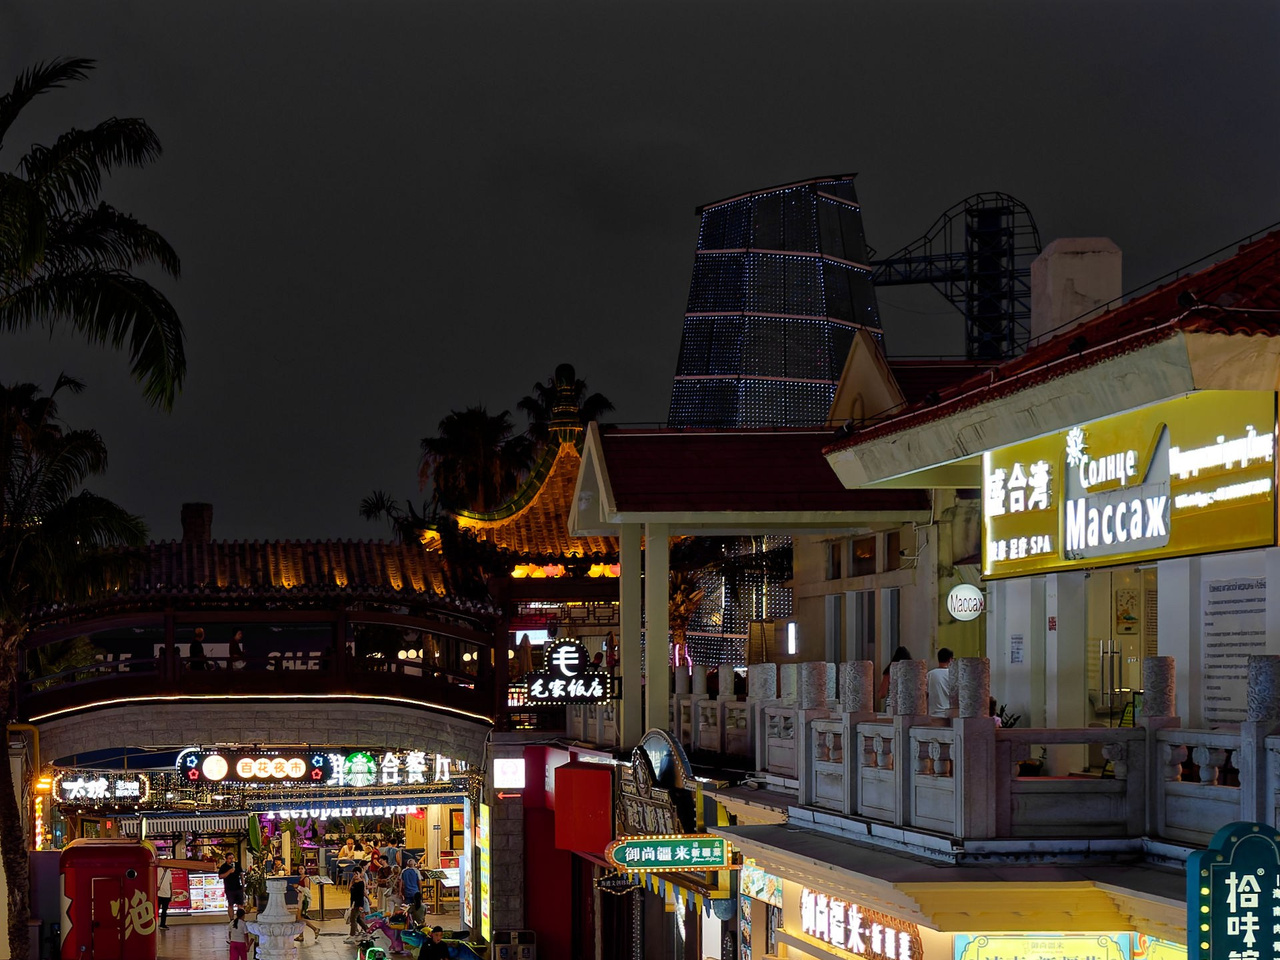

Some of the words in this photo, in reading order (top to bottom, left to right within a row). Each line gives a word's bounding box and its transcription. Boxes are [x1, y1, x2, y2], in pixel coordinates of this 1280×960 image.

[1080, 449, 1138, 488] Солнце
[1066, 496, 1168, 550] Массаж
[1030, 535, 1051, 555] SPA
[949, 594, 985, 614] Массаж
[531, 678, 604, 698] 毛家饭店
[240, 760, 302, 774] 百花夜市
